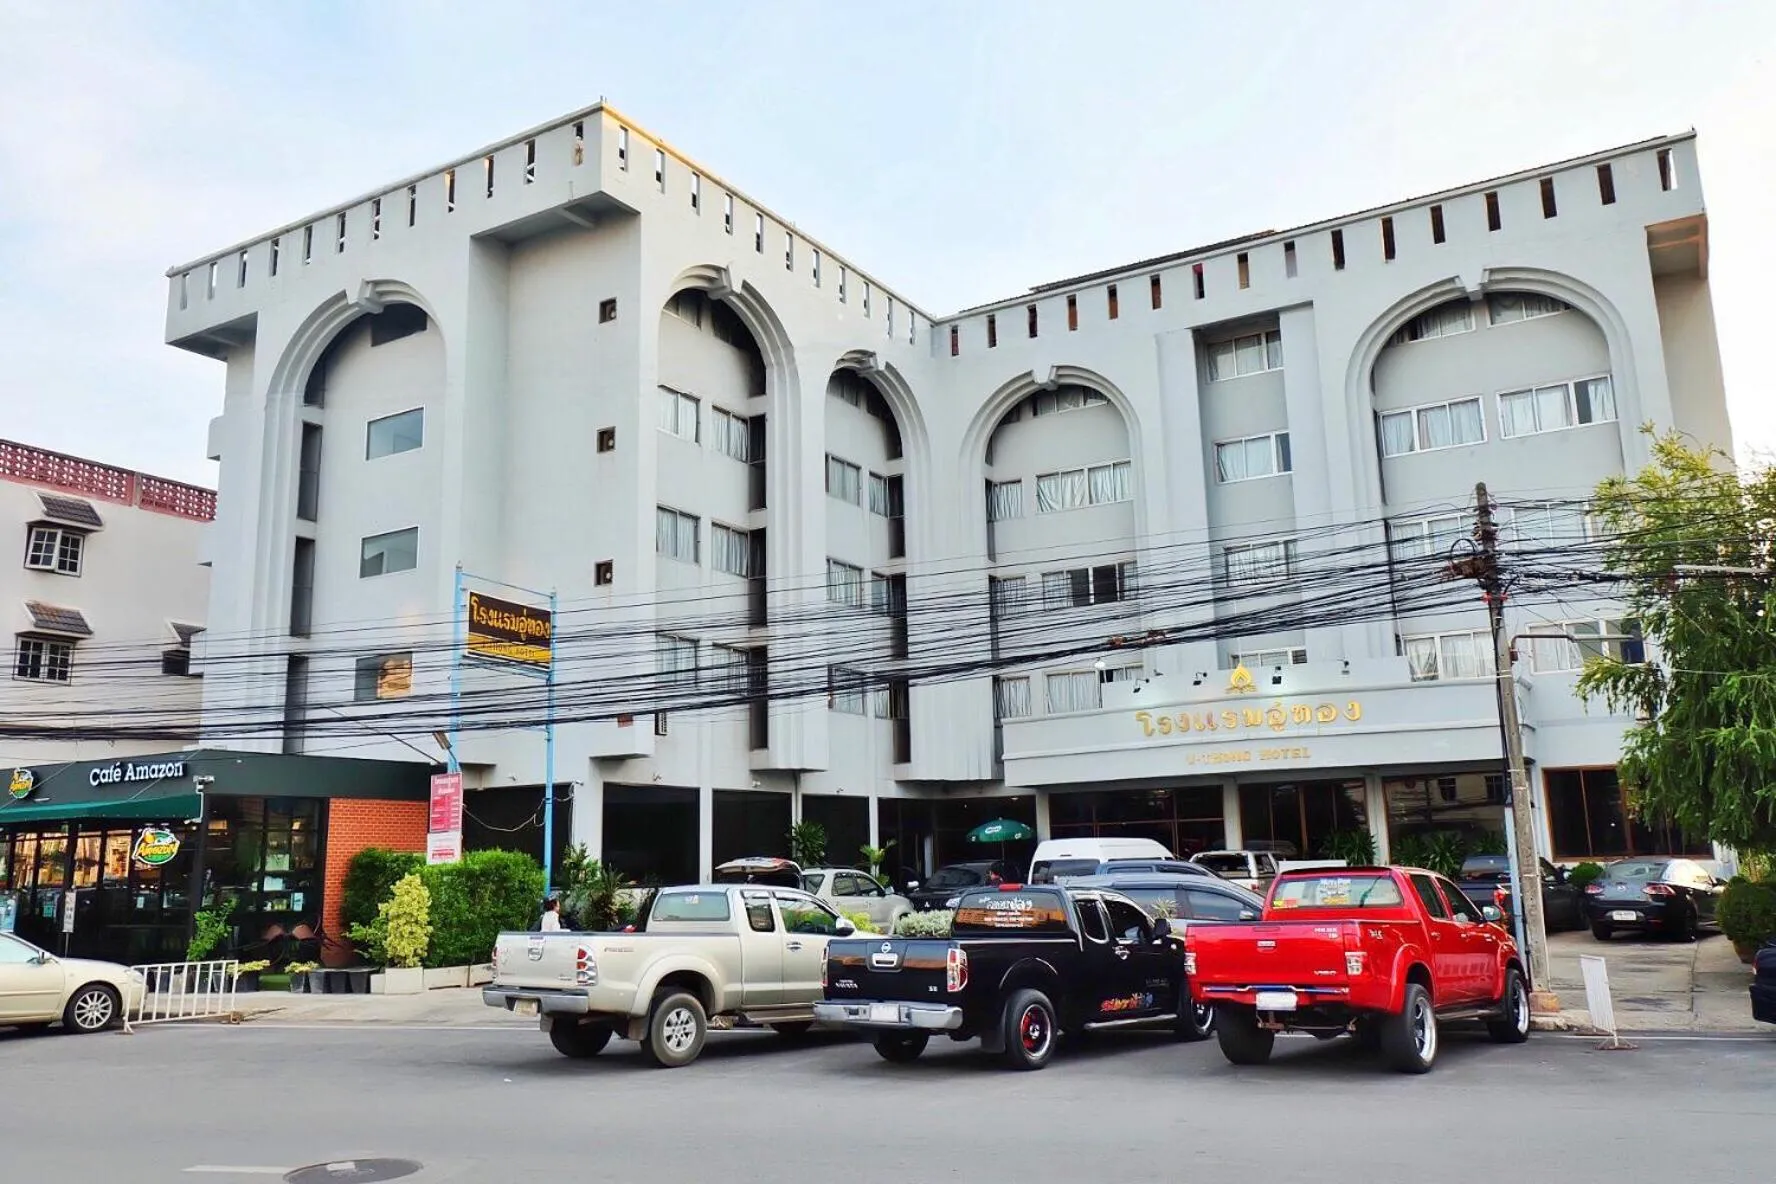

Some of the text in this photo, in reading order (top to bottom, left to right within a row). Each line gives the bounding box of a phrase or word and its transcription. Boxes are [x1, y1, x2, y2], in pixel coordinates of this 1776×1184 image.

[470, 595, 551, 641] โรงแรมอู่ทอง
[1135, 700, 1362, 737] โรงแรมอู่ทอง
[1259, 746, 1311, 761] HOTEL
[89, 761, 185, 786] Café Amazon
